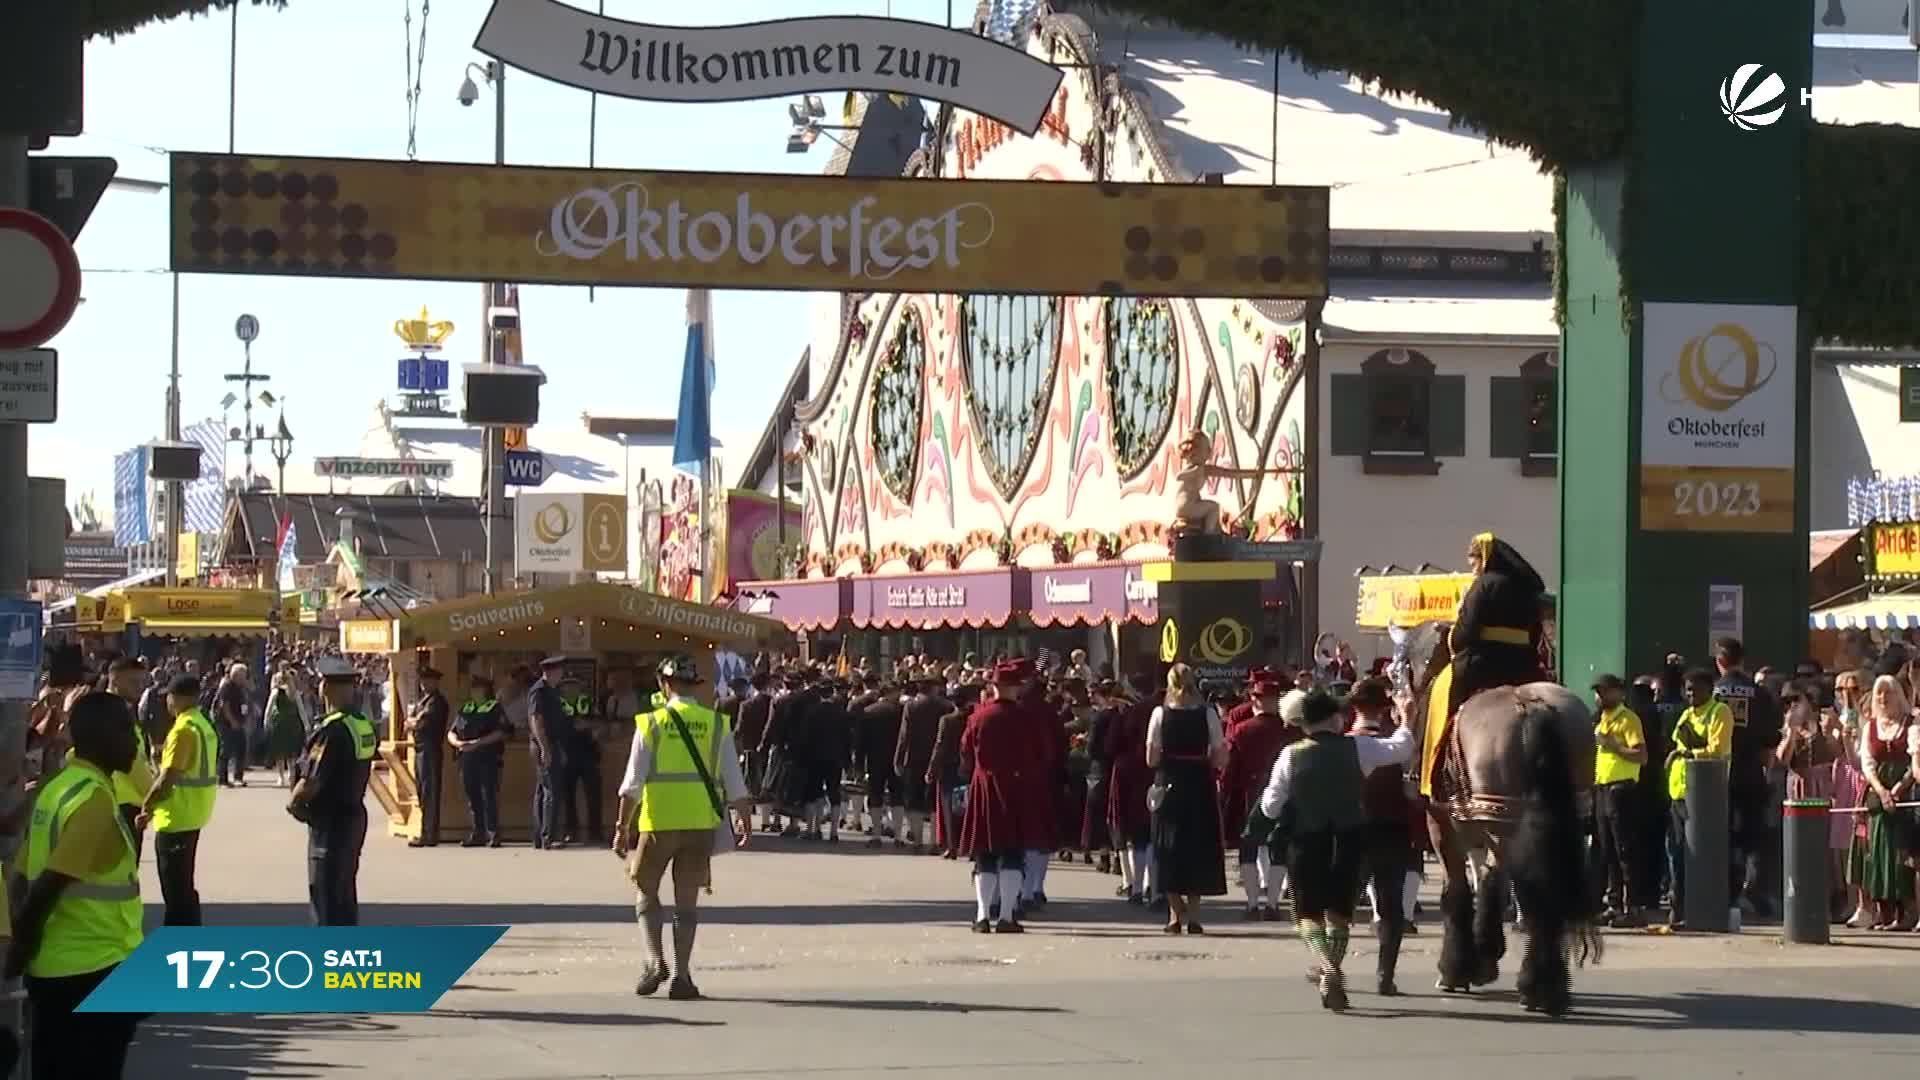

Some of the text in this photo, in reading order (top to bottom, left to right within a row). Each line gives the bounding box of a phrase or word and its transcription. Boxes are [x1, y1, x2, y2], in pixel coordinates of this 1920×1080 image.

[579, 28, 962, 88] Willkommen zum
[537, 182, 994, 281] Oktoberfest
[1667, 416, 1766, 439] Oktoberfest
[319, 459, 451, 476] vinzenzmurr
[509, 458, 541, 480] WC
[1673, 481, 1761, 518] 2023
[167, 597, 200, 611] Lose
[449, 599, 545, 633] Souvenirs
[646, 599, 757, 637] Information
